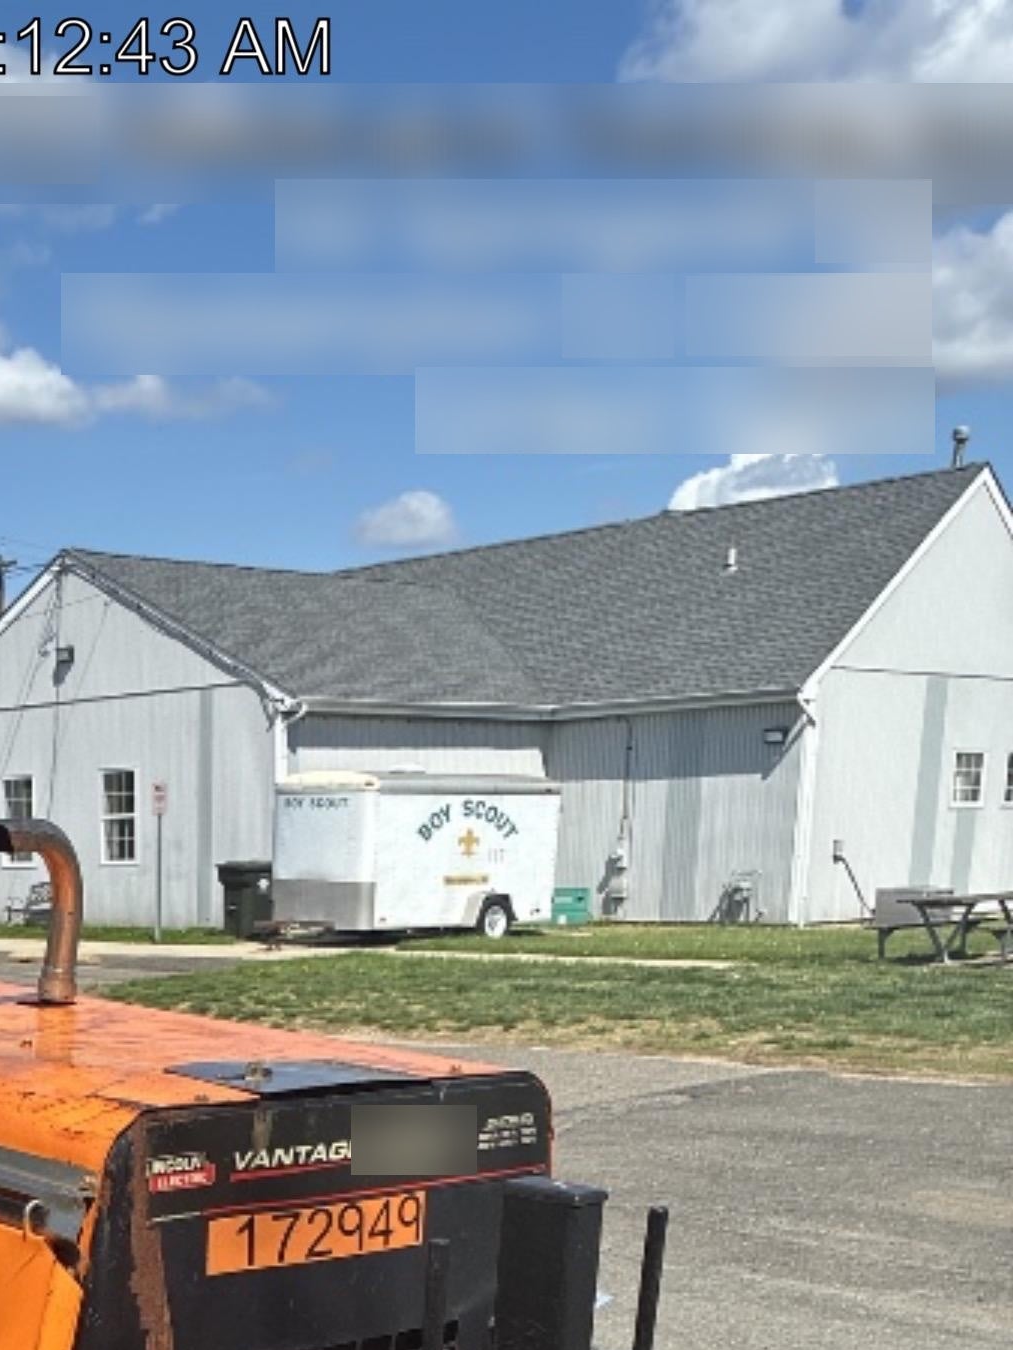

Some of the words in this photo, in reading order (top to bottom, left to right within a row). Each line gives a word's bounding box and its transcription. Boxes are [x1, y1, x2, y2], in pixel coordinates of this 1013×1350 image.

[418, 803, 450, 841] BOY
[463, 799, 519, 839] SCOUT
[235, 1192, 422, 1267] 172949
